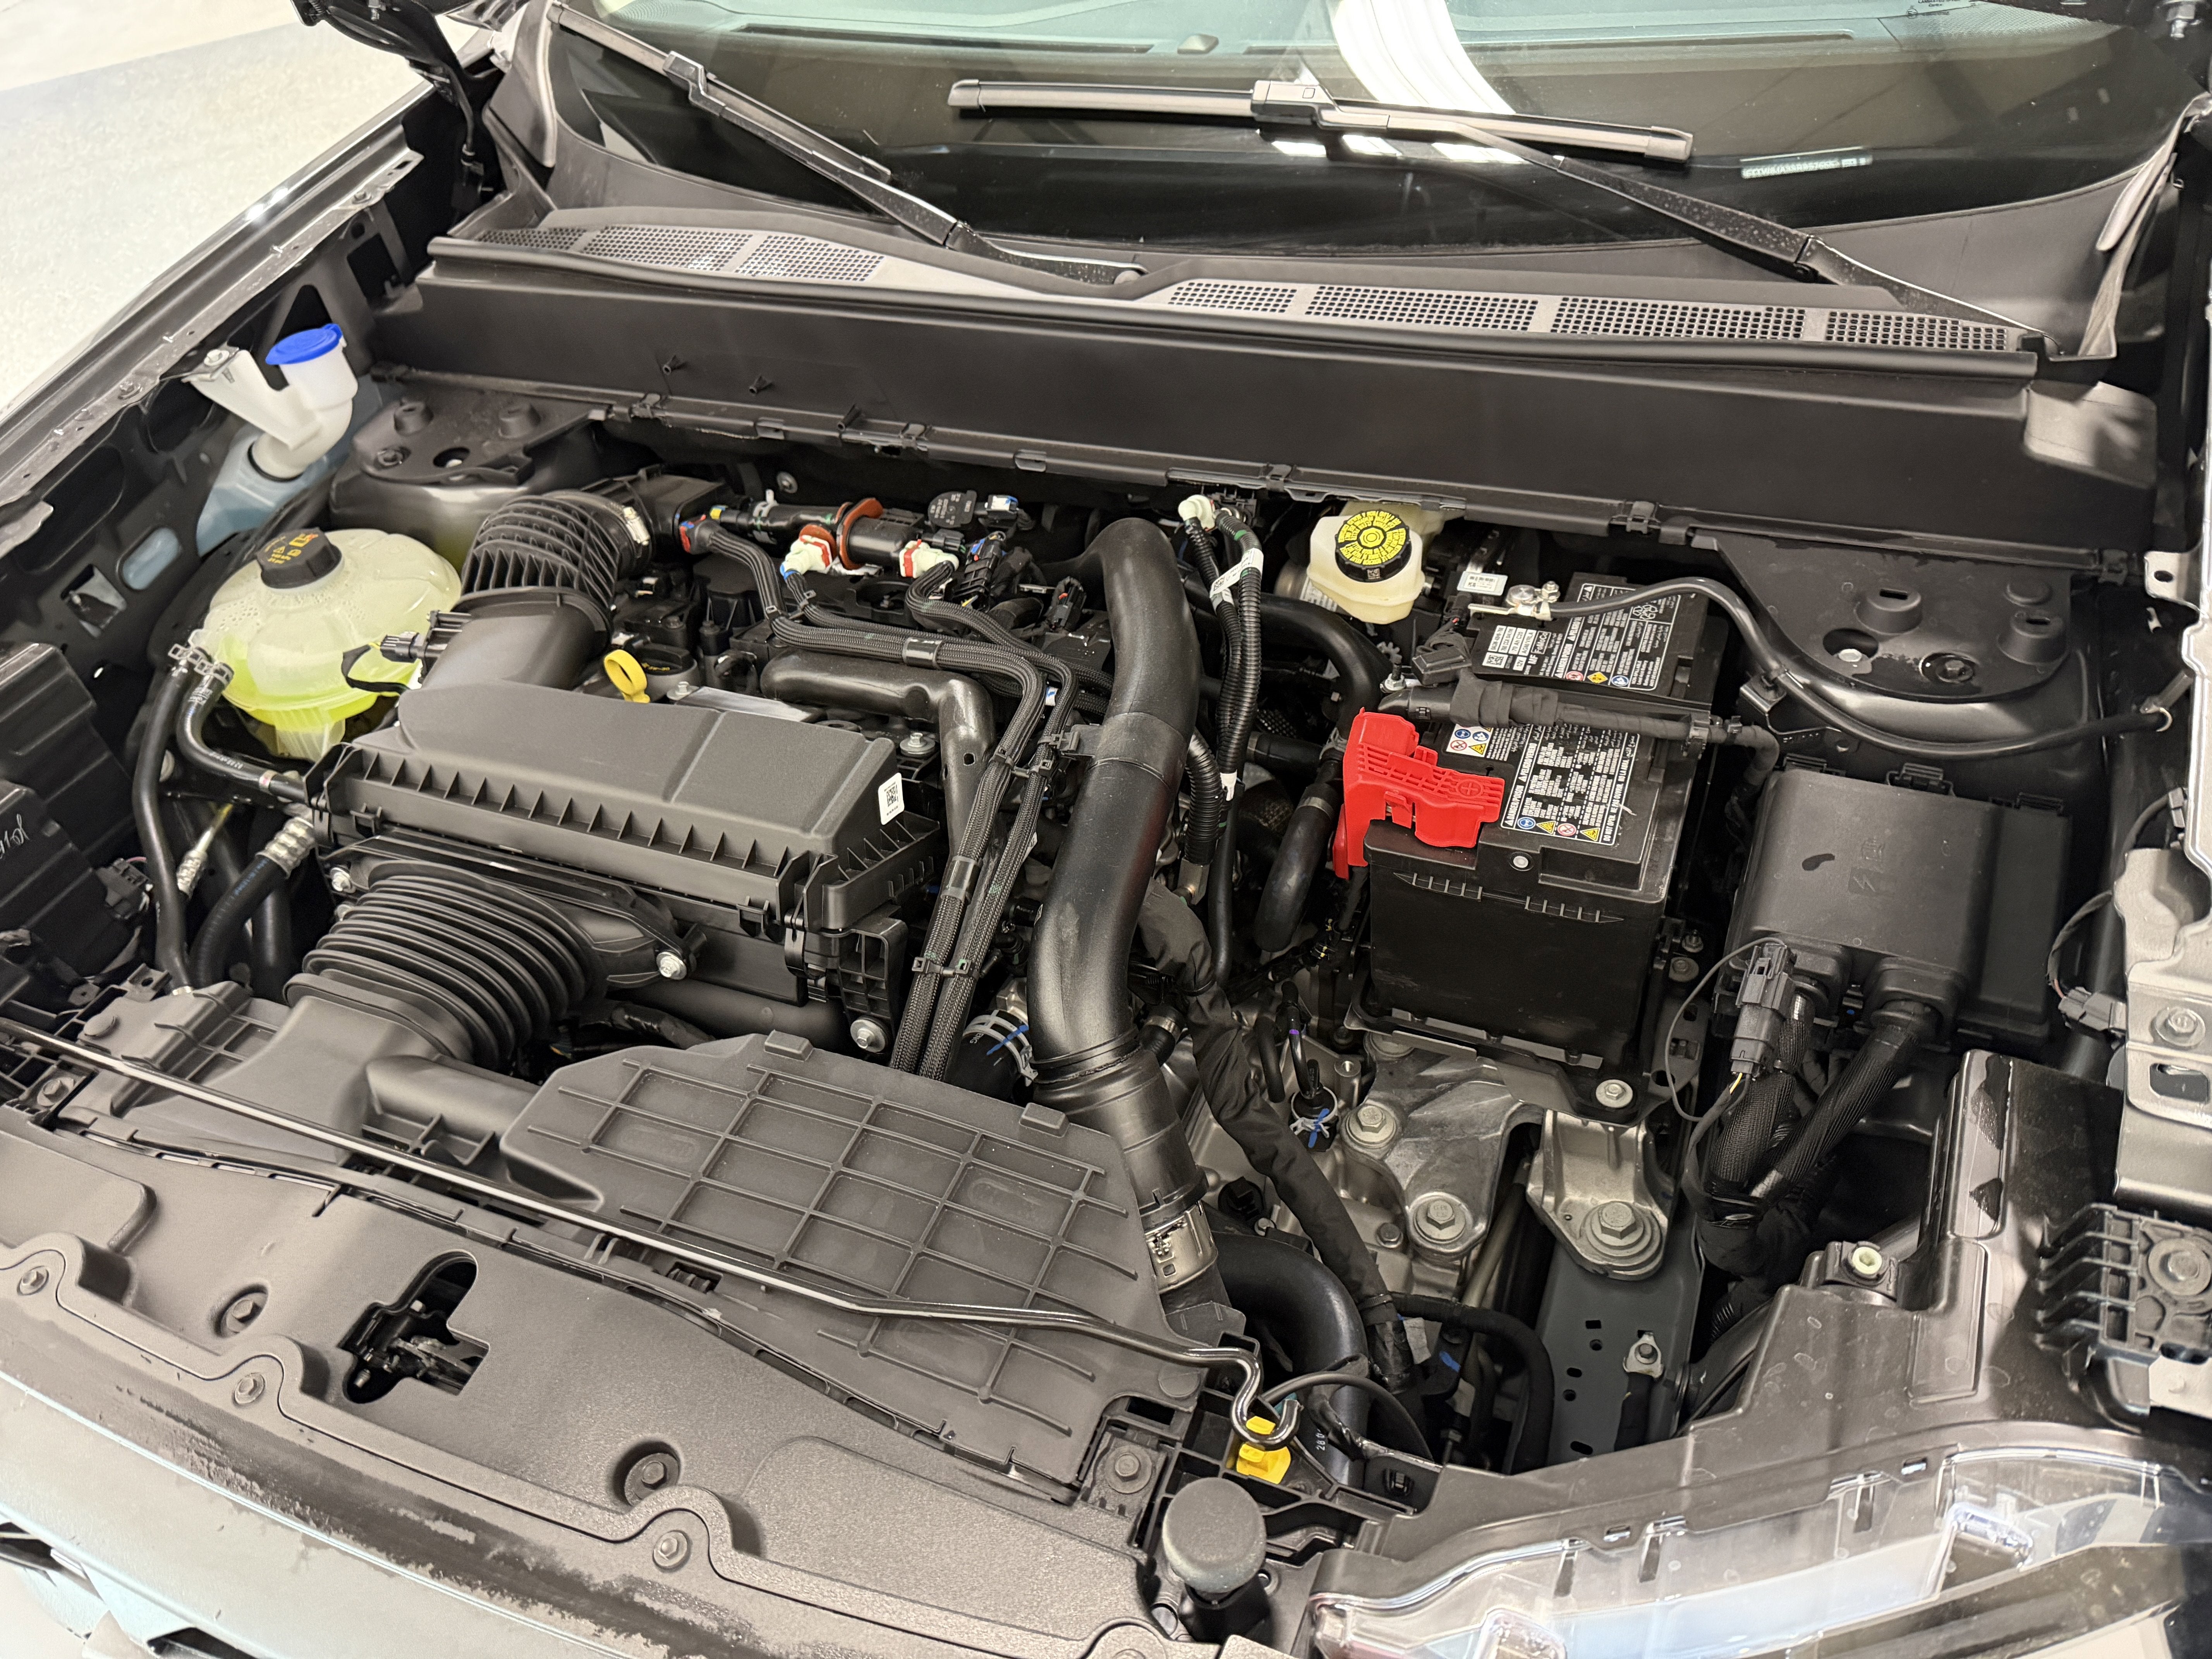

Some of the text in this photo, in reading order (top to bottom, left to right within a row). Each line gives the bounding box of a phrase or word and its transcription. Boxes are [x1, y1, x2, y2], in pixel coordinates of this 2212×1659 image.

[1521, 632, 1534, 653] AGM/VRLA
[1533, 632, 1548, 653] FoMoCo
[1520, 742, 1537, 776] PELIGRO/VENENO
[1613, 783, 1623, 799] OUVRIR.
[1506, 785, 1524, 820] DANGER/POISON
[1611, 799, 1620, 807] PAS
[1607, 814, 1616, 826] OPEN.
